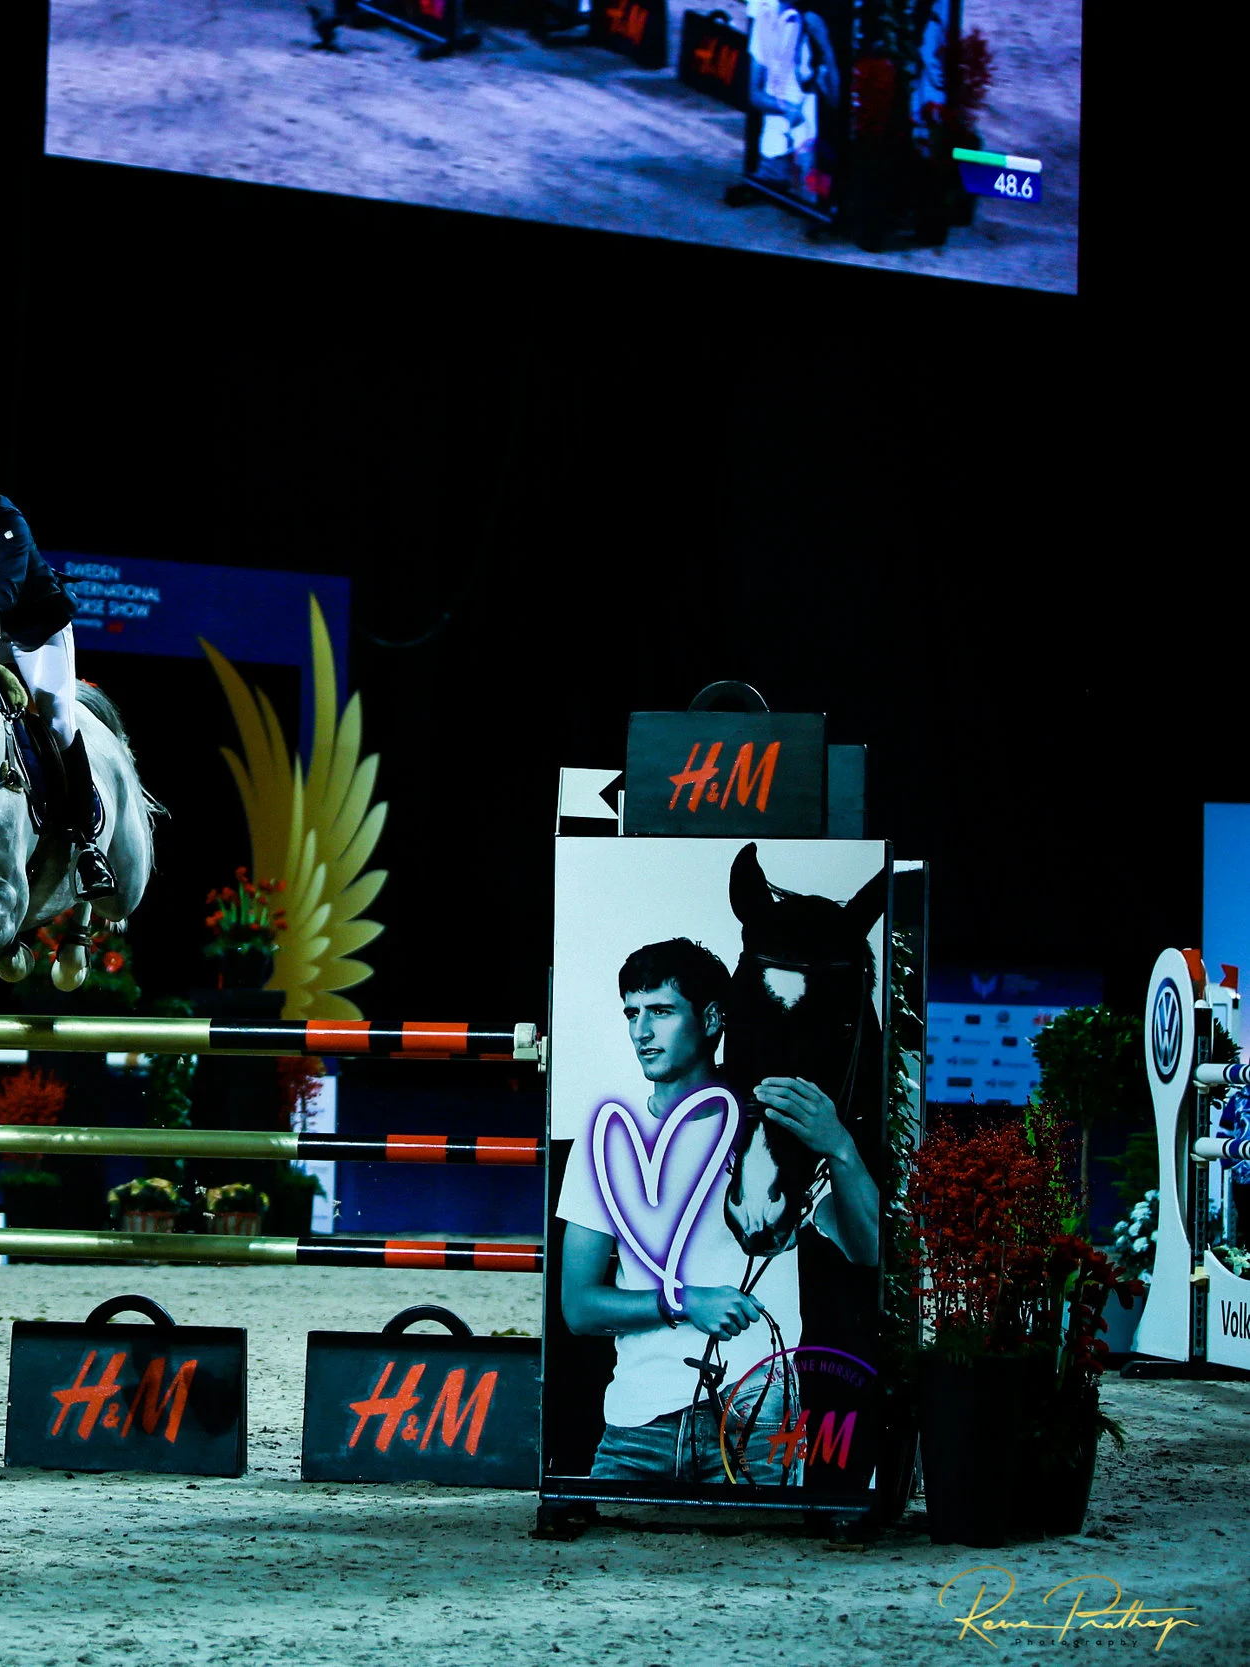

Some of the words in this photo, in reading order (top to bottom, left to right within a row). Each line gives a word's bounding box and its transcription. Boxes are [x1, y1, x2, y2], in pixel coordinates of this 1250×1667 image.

[993, 172, 1034, 199] 48.6
[64, 561, 120, 581] SWEDEN
[67, 581, 161, 603] NTERNATIONAL
[76, 599, 105, 615] ORSE
[108, 600, 150, 618] SHOW
[668, 741, 781, 813] H&M
[51, 1350, 198, 1444] H&M
[349, 1361, 499, 1457] H&M
[766, 1409, 857, 1470] H&M
